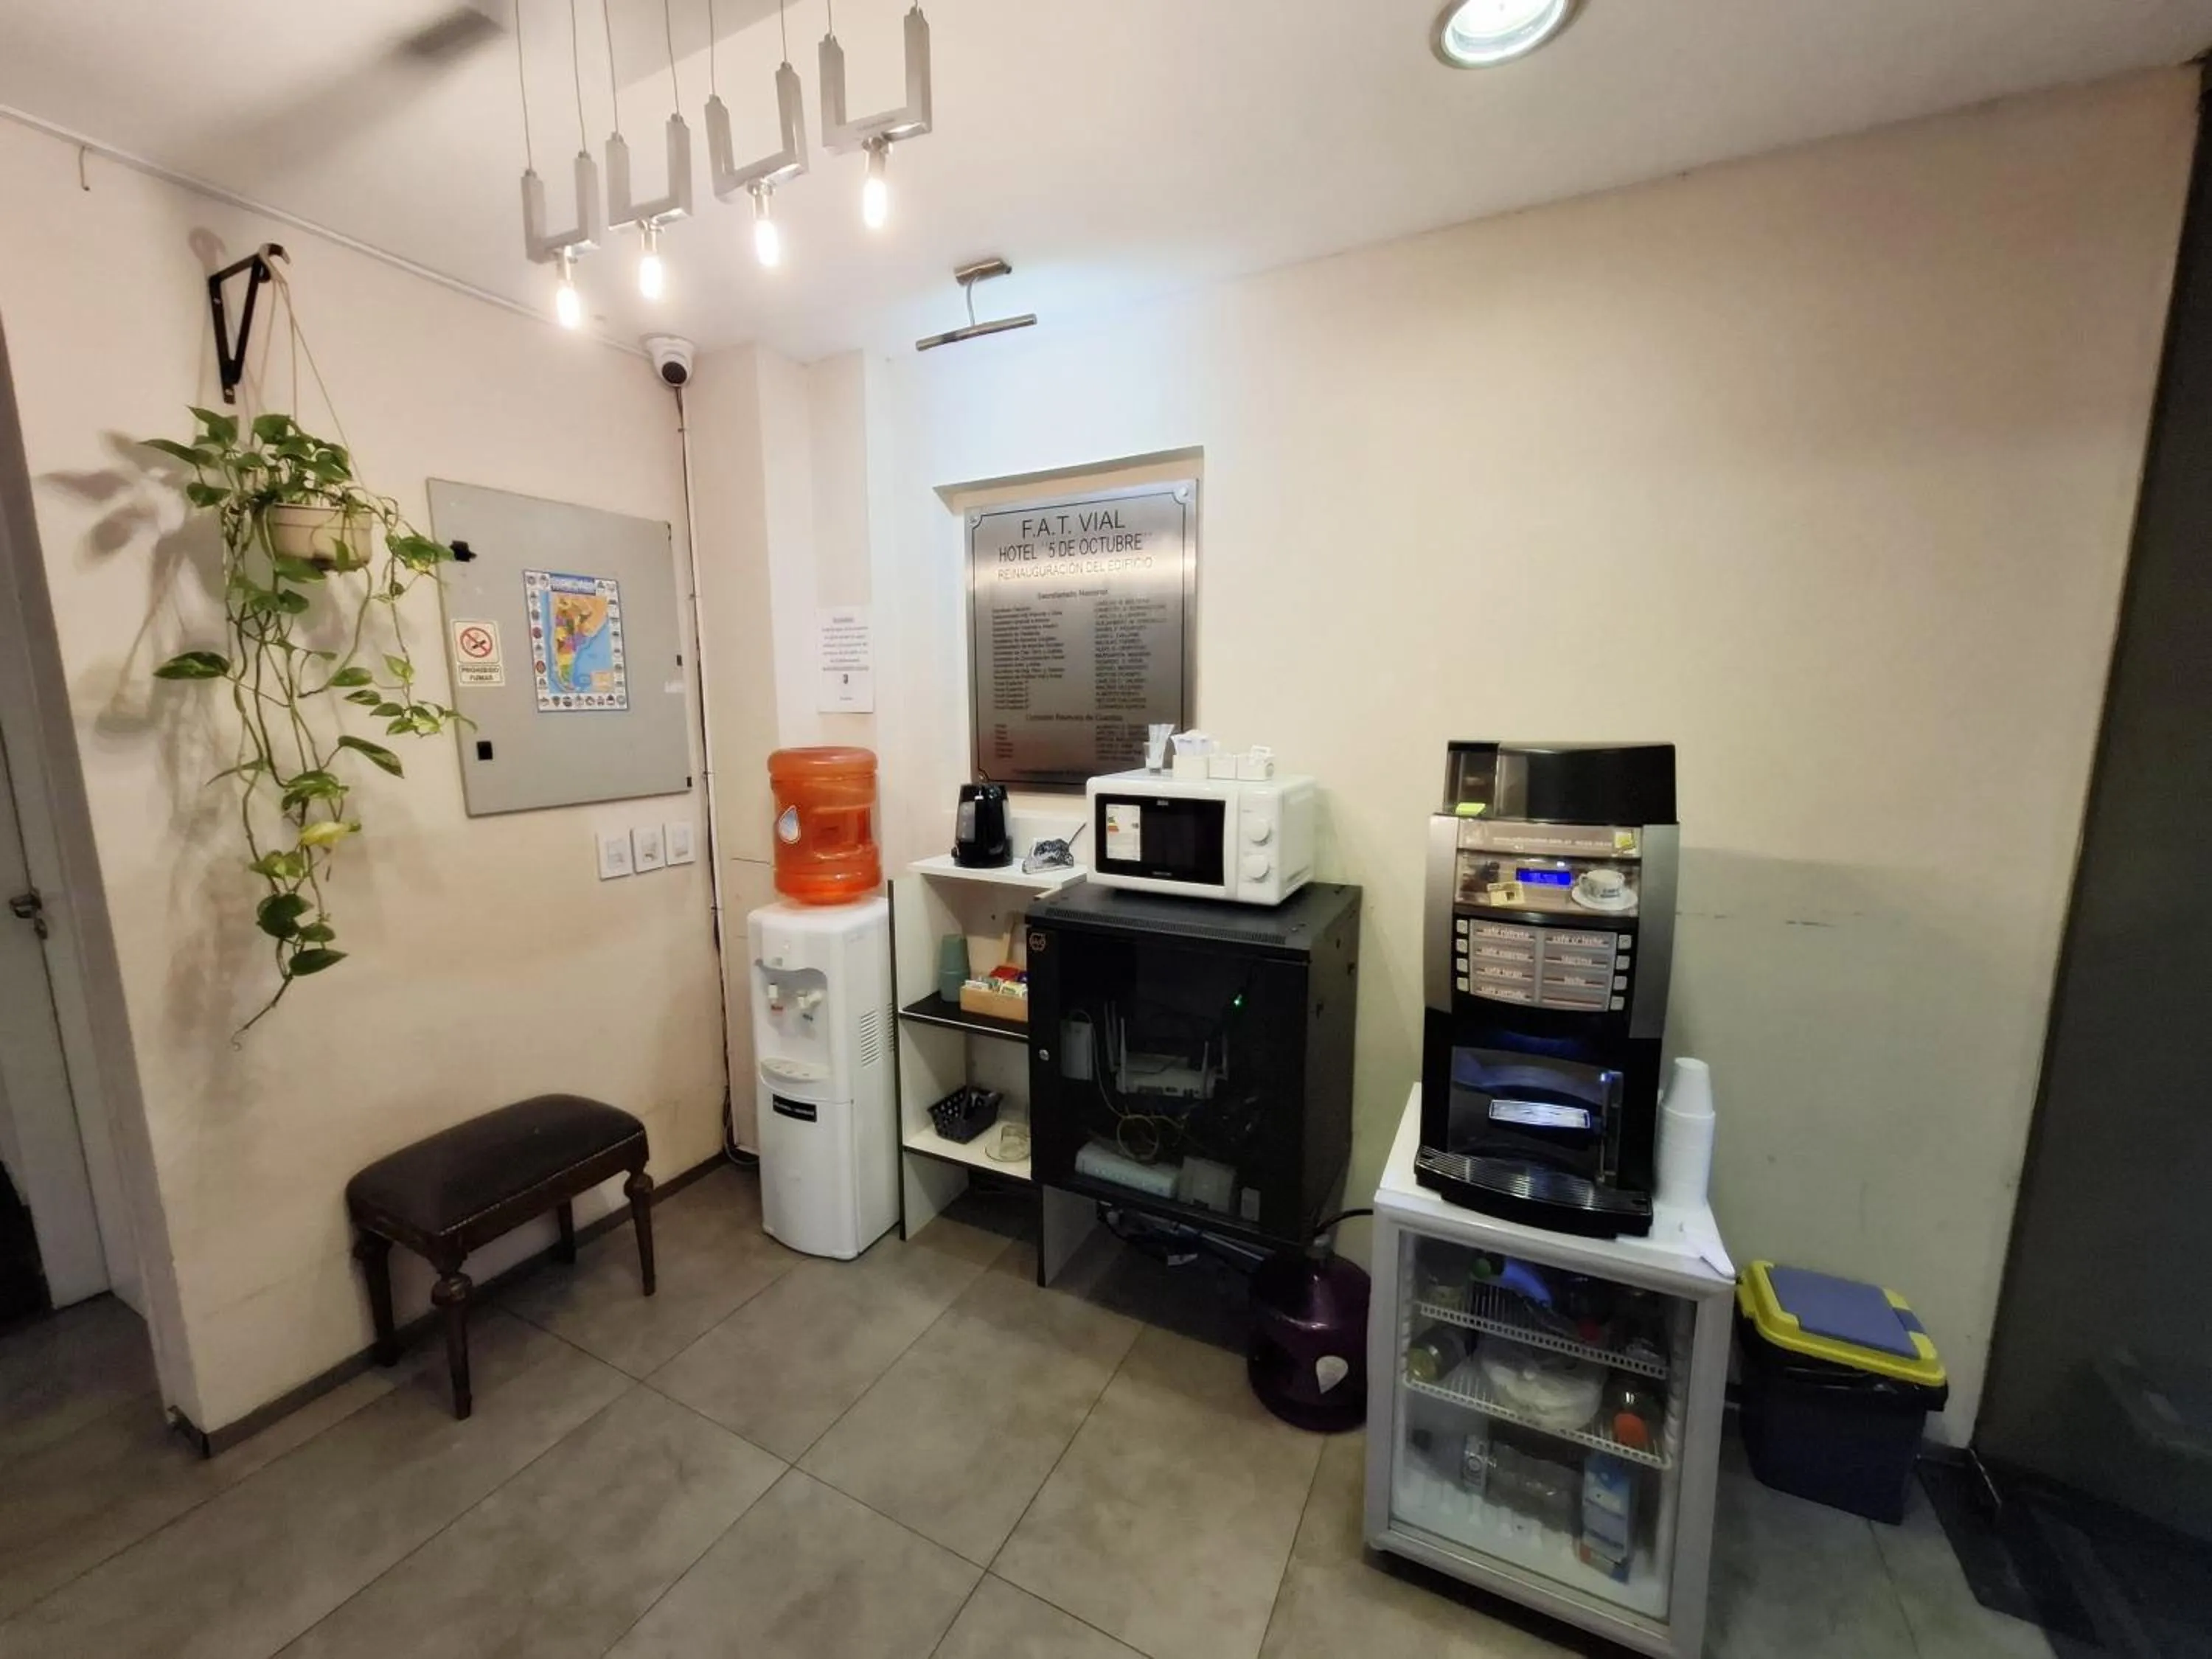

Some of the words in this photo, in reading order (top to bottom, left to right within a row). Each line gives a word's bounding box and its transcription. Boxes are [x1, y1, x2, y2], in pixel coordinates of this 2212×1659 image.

[1022, 515, 1072, 539] F.A.T.
[1079, 509, 1126, 532] VIAL
[998, 543, 1037, 563] HOTEL
[1058, 539, 1076, 557] DE
[1086, 560, 1105, 573] DEL
